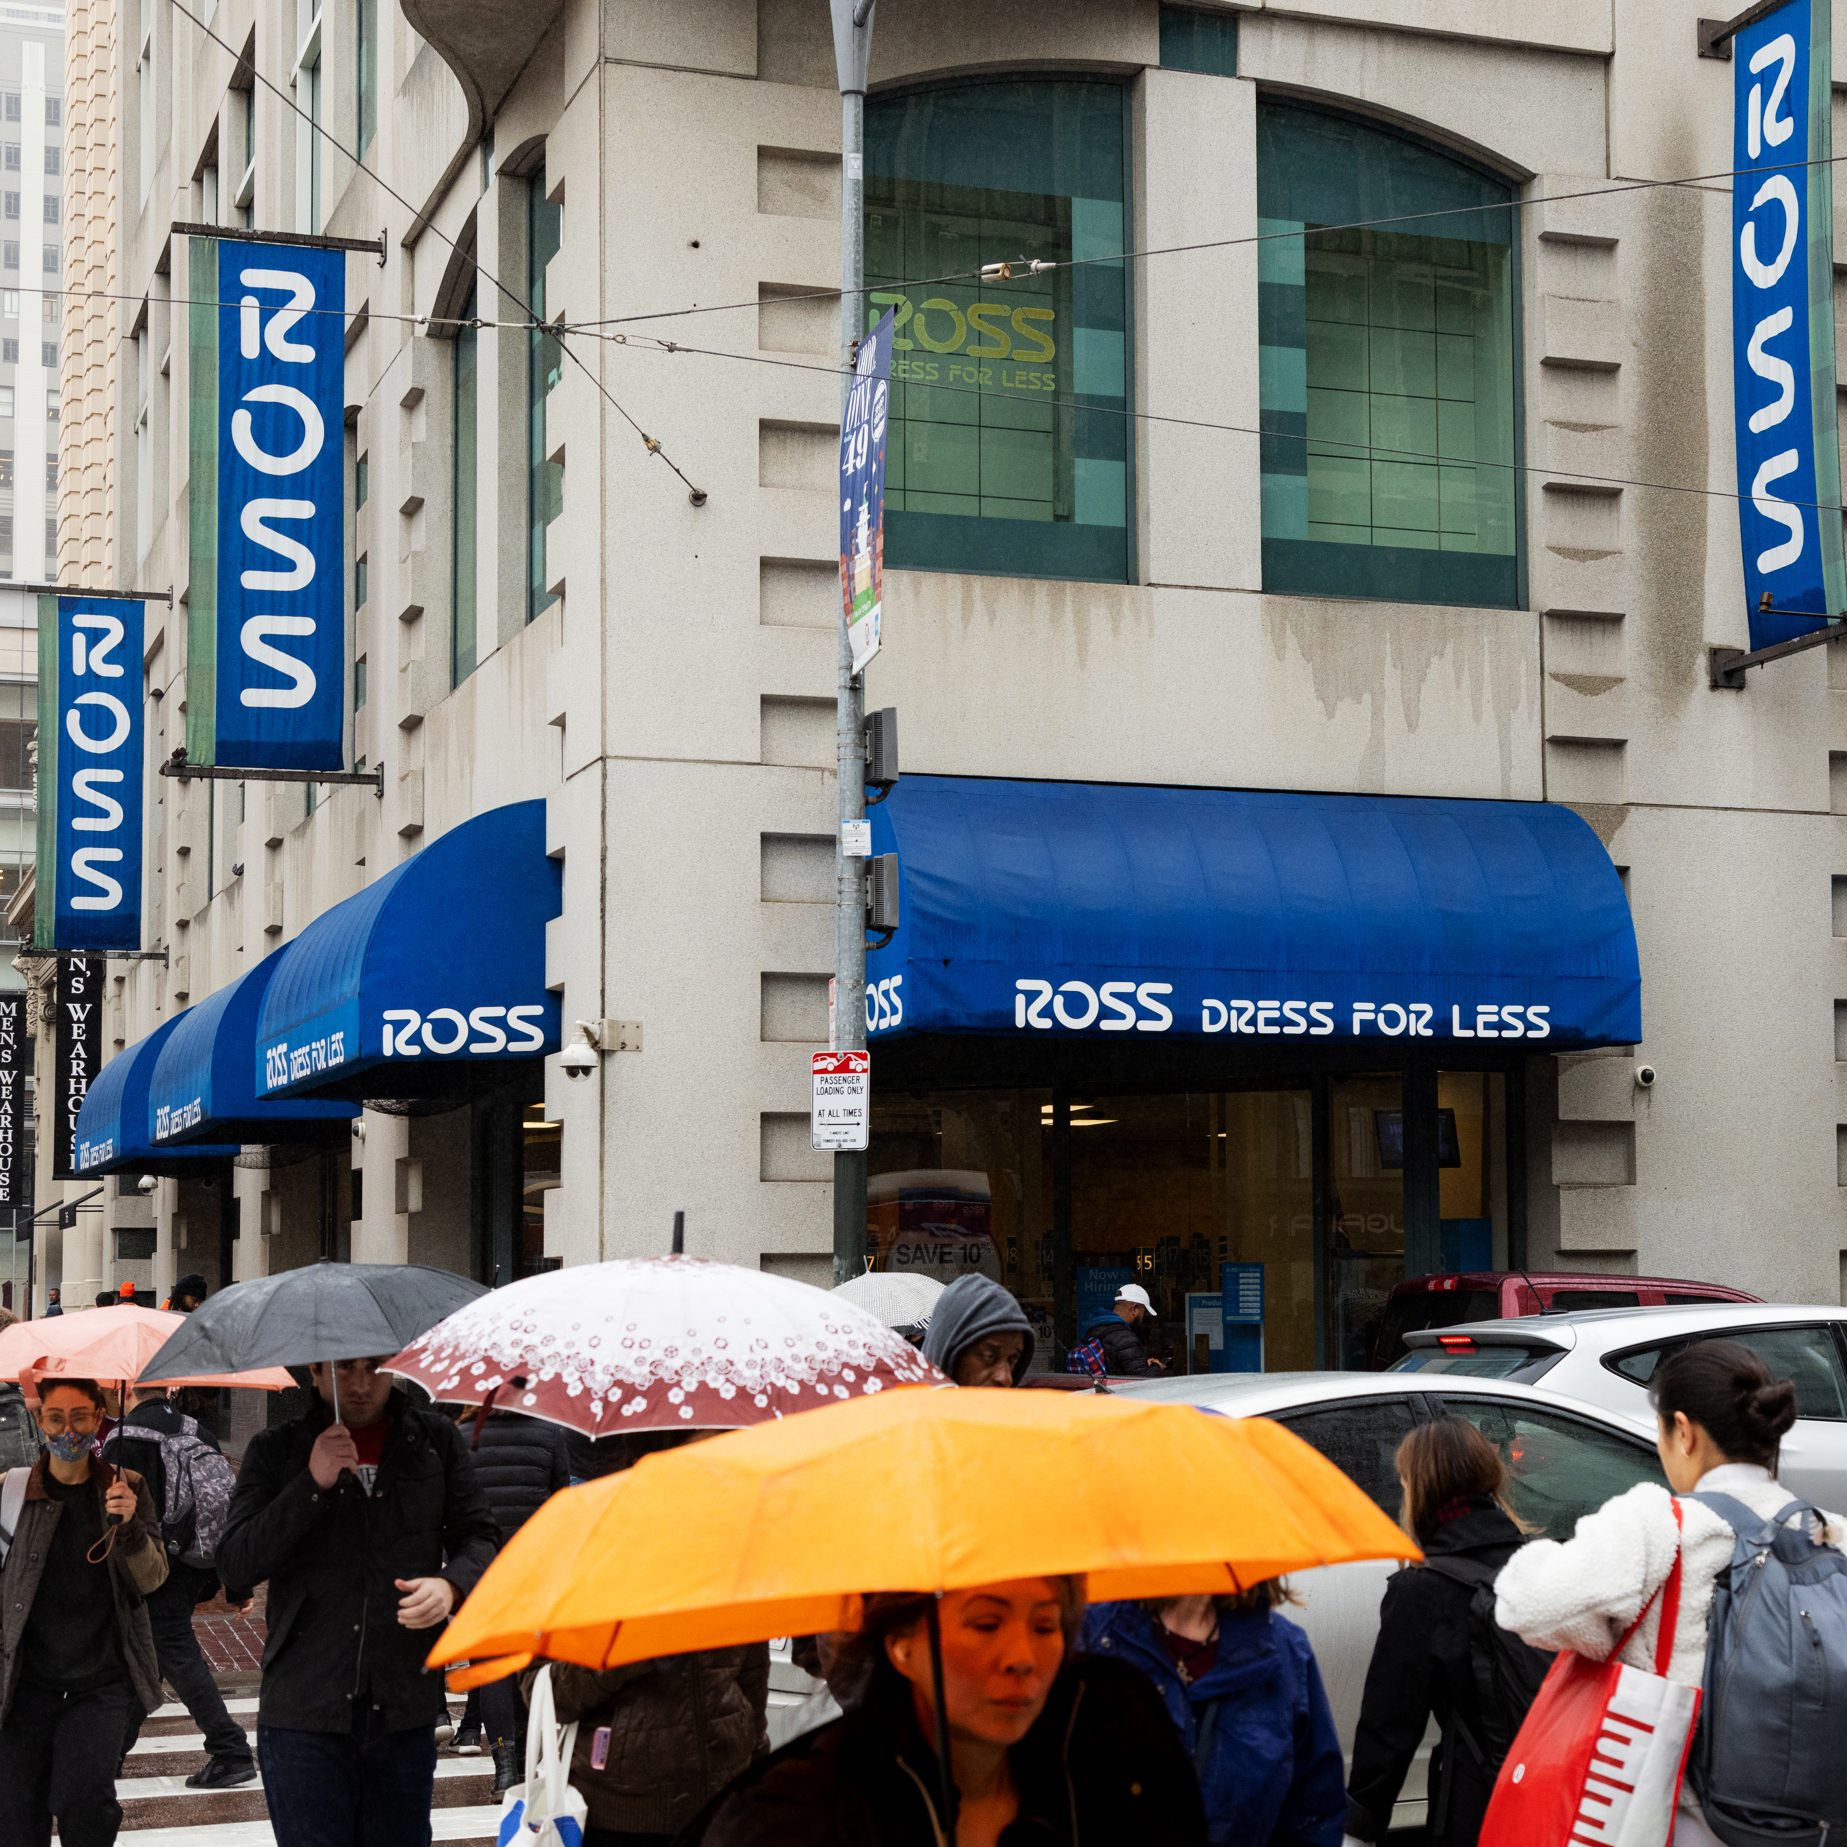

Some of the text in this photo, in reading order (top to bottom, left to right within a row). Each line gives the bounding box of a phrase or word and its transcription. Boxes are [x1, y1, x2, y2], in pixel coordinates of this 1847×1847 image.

[869, 292, 1056, 363] ROSS
[1741, 34, 1804, 575] ROSS
[890, 360, 1056, 391] RESS FOR LESS
[842, 424, 868, 476] 49
[231, 269, 325, 708] ROSS
[66, 614, 131, 910] ROSS
[382, 1005, 545, 1056] ROSS
[866, 975, 903, 1032] OSS
[1015, 979, 1551, 1038] ROSS DRESS FOR LESS
[266, 1031, 345, 1089] ROSS DRESS FOR LESS
[820, 1076, 860, 1084] PASSENGER
[0, 1002, 17, 1202] MEN'S WEARHOUSE
[816, 1086, 864, 1095] LOADING ONLY
[828, 1109, 840, 1117] ALL
[843, 1109, 862, 1117] TIMES
[896, 1242, 992, 1264] SAVE 10%
[1088, 1269, 1119, 1280] Now
